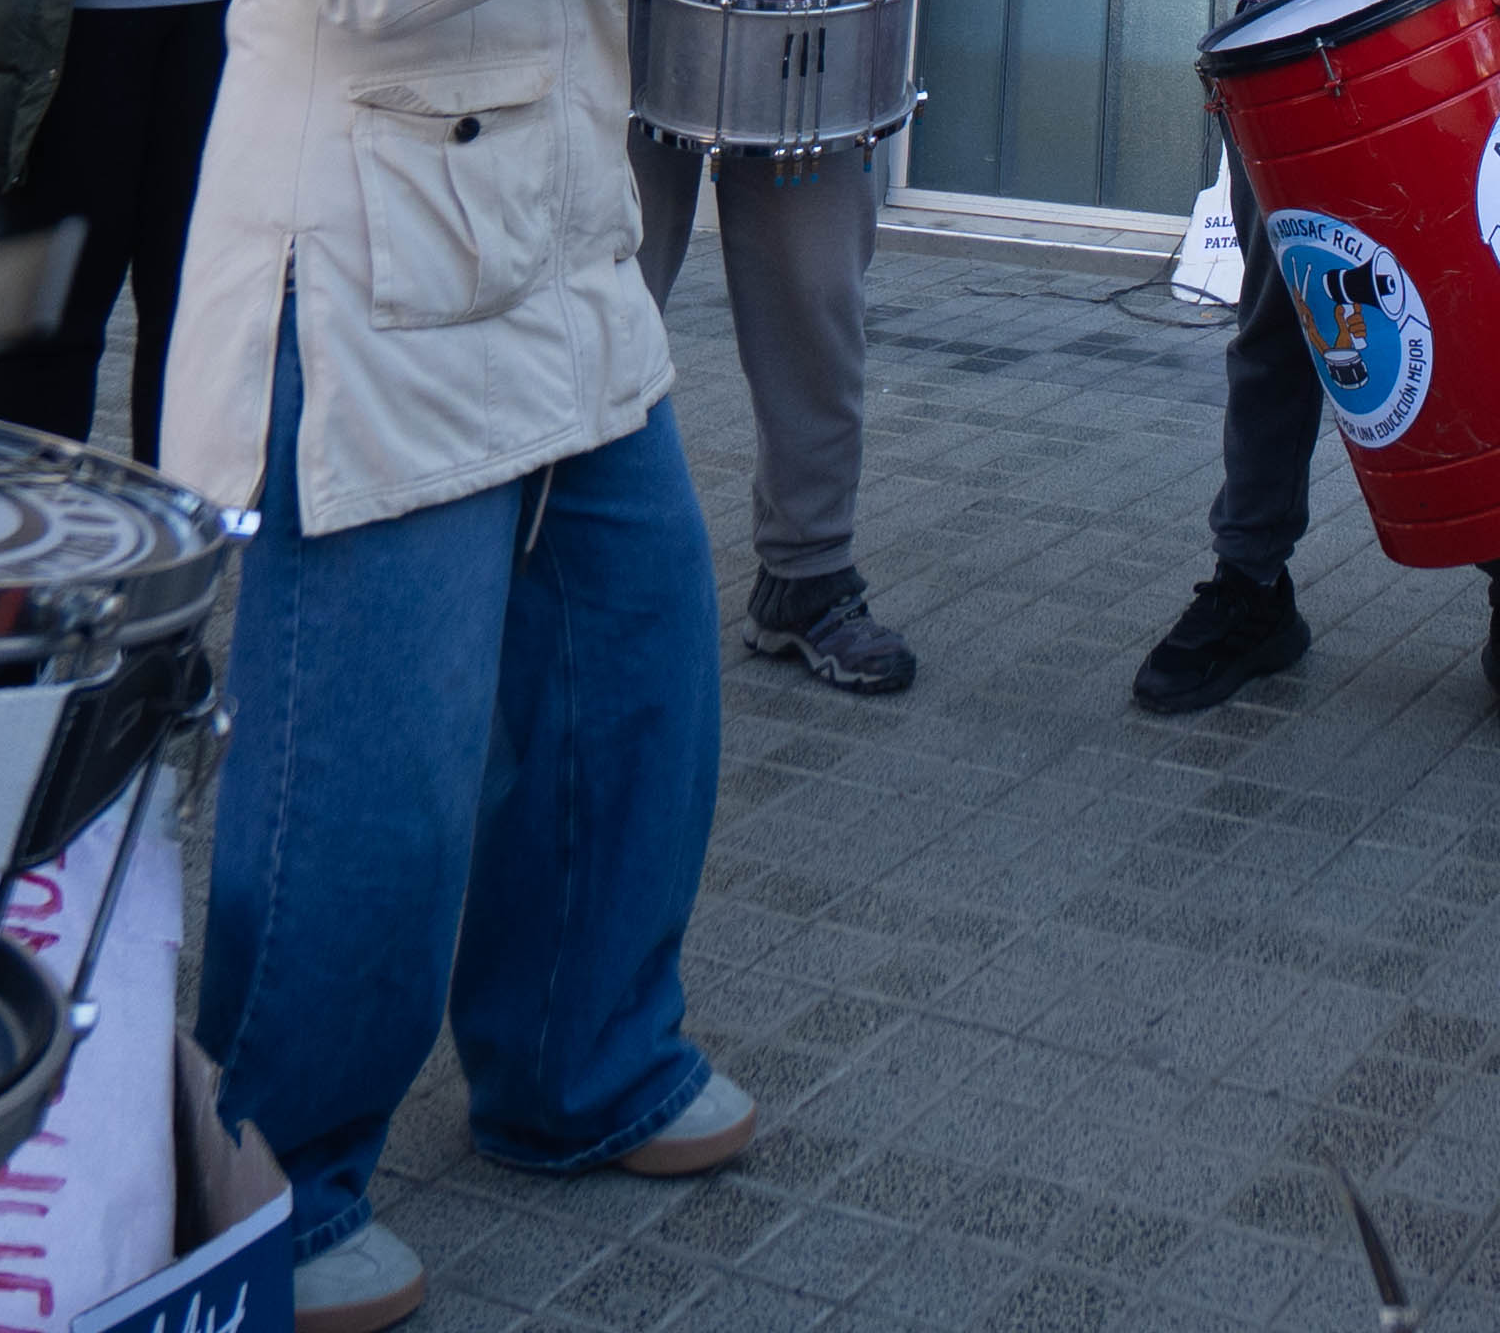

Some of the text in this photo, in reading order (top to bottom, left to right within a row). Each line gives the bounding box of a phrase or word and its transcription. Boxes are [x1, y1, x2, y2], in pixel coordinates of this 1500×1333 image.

[1277, 218, 1326, 242] ADOSAC
[1333, 229, 1363, 262] RGL
[1357, 424, 1376, 443] UNA
[1375, 383, 1418, 439] EDUCACIÓN
[1408, 337, 1427, 386] MEJOR
